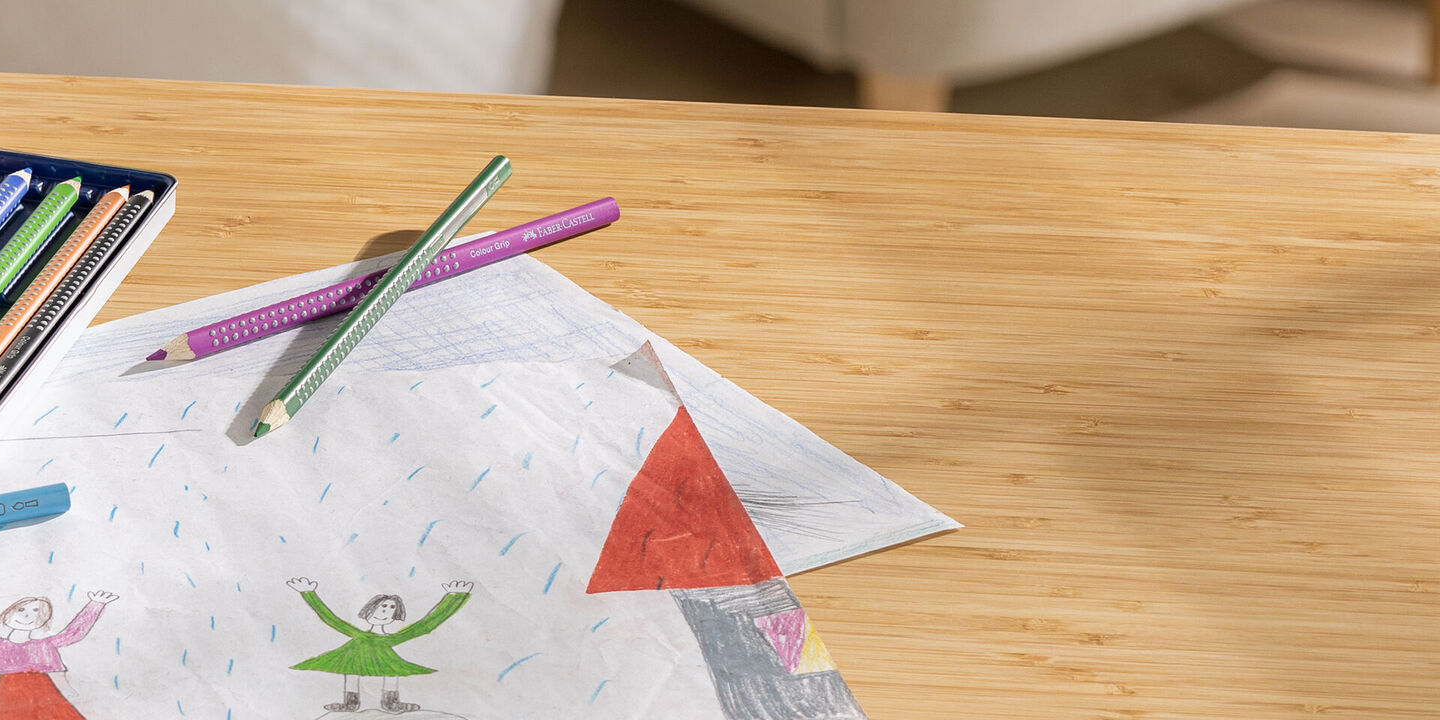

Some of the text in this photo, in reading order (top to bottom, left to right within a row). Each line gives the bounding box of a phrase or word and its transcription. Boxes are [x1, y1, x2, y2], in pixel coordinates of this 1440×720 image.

[537, 212, 596, 238] FABER-CASTELL
[470, 239, 510, 259] Colour Grip
